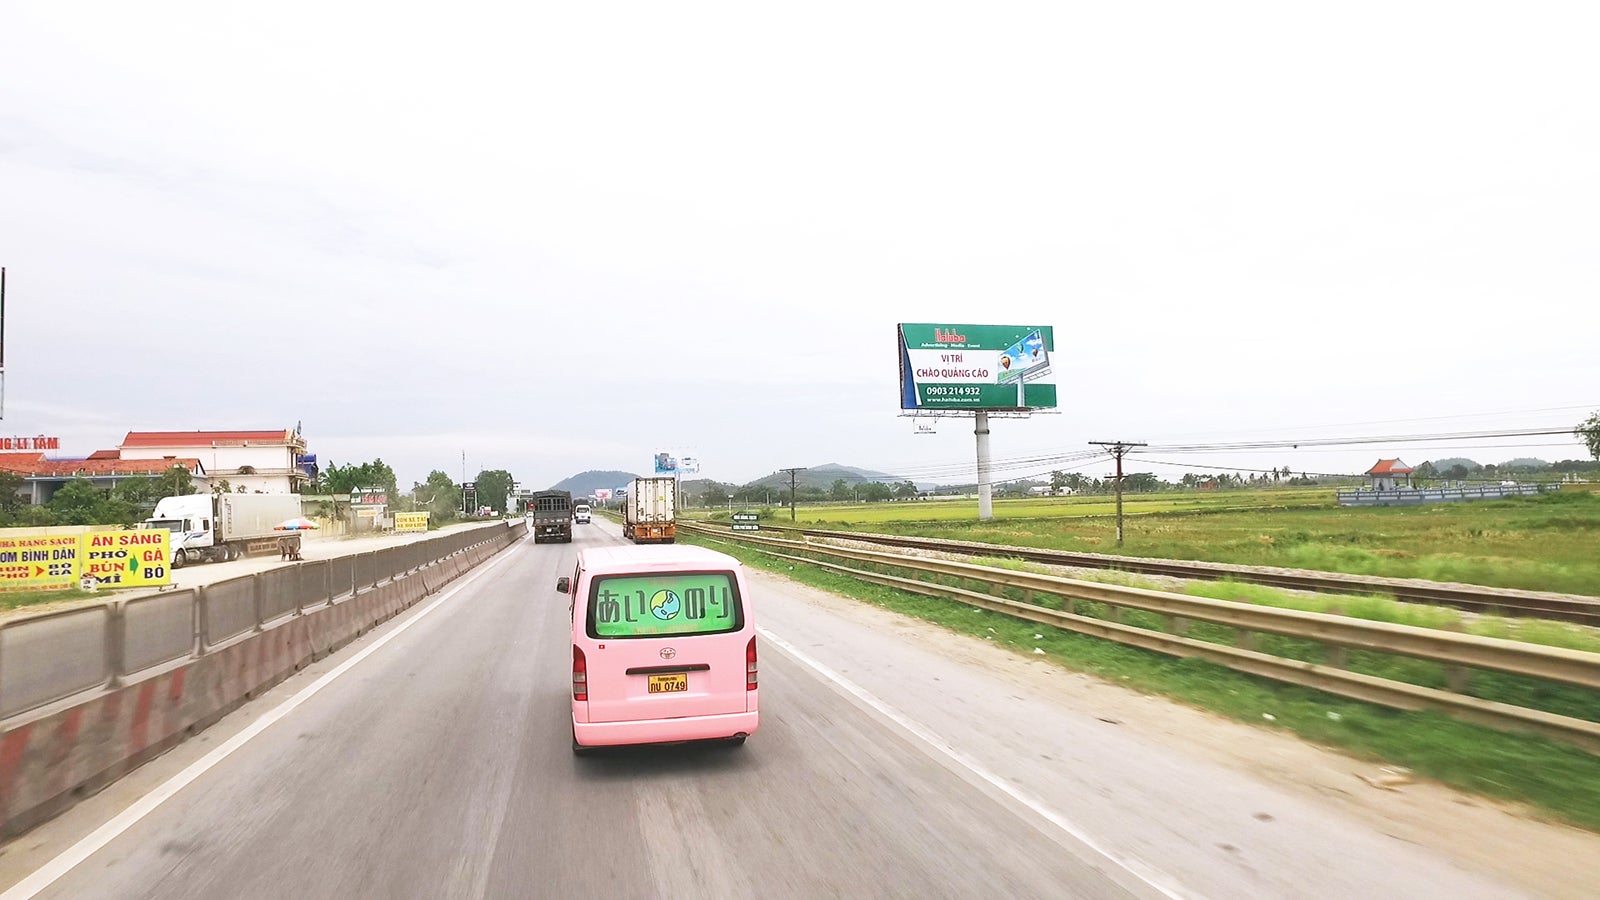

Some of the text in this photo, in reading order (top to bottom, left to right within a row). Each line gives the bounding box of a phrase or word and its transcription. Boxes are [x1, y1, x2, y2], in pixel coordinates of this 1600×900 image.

[950, 353, 963, 363] TRÍ
[916, 366, 989, 379] CHÀO QUẢNG CÁO
[32, 434, 58, 449] TÂM
[92, 533, 162, 546] ĂN SÁNG
[53, 547, 75, 560] DÂN
[90, 561, 125, 573] BÚN
[599, 586, 729, 623] あい のり
[664, 681, 686, 691] 0749
